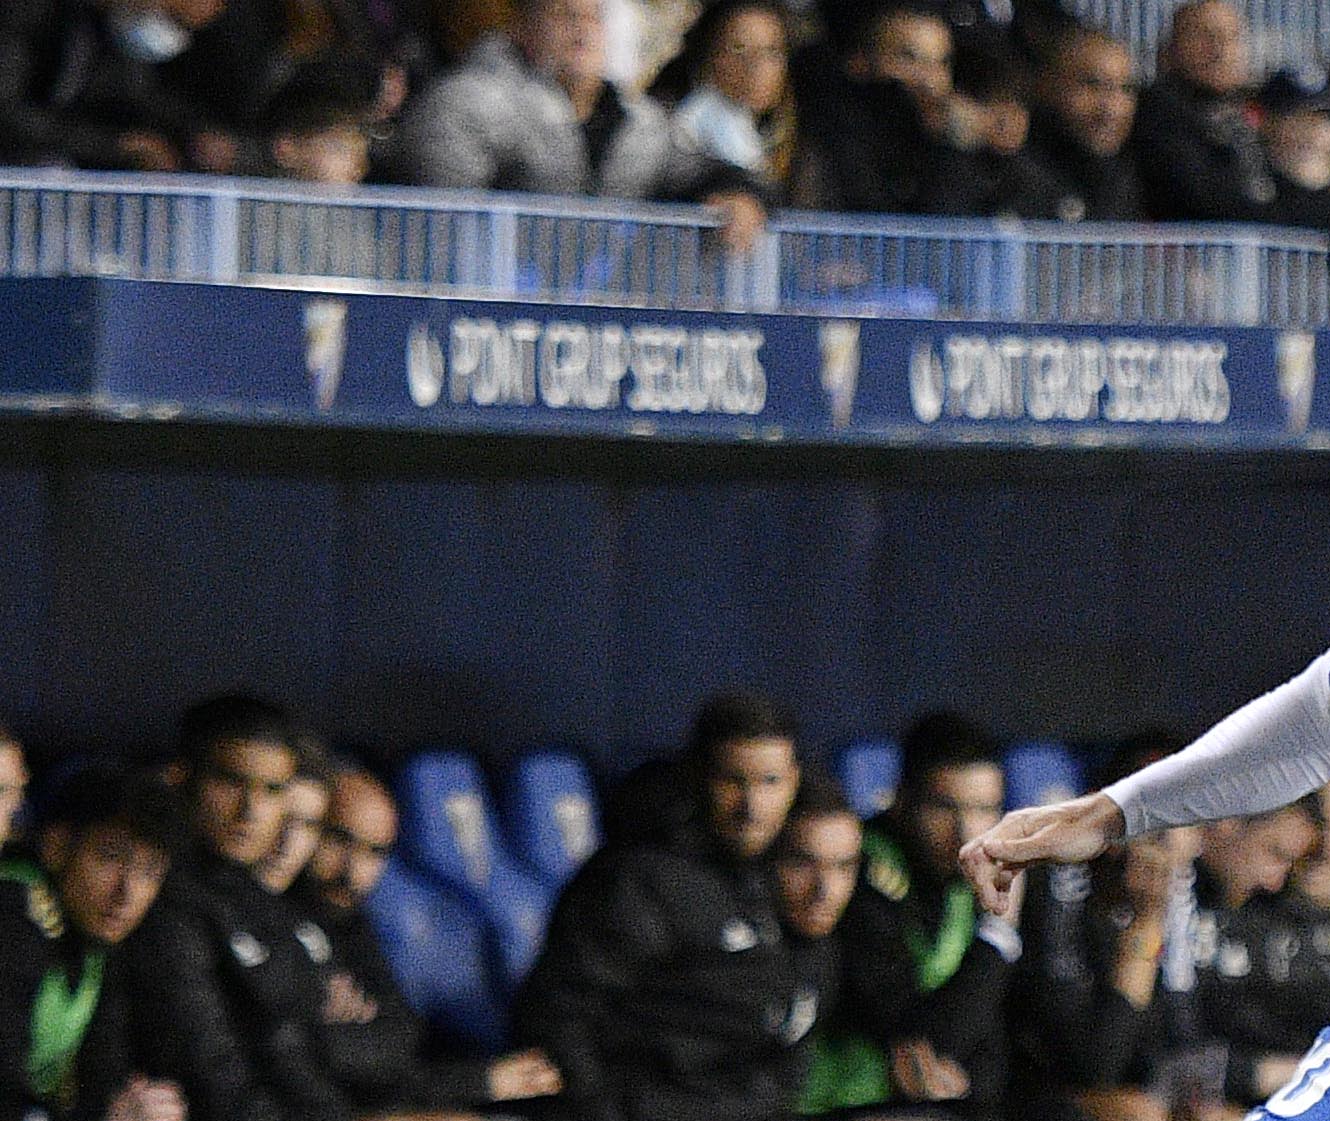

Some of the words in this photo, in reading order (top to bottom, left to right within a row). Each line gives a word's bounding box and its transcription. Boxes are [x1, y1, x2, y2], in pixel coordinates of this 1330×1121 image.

[451, 318, 541, 405] PONT
[541, 322, 622, 410] GRUP
[626, 326, 767, 415] SEGUROS
